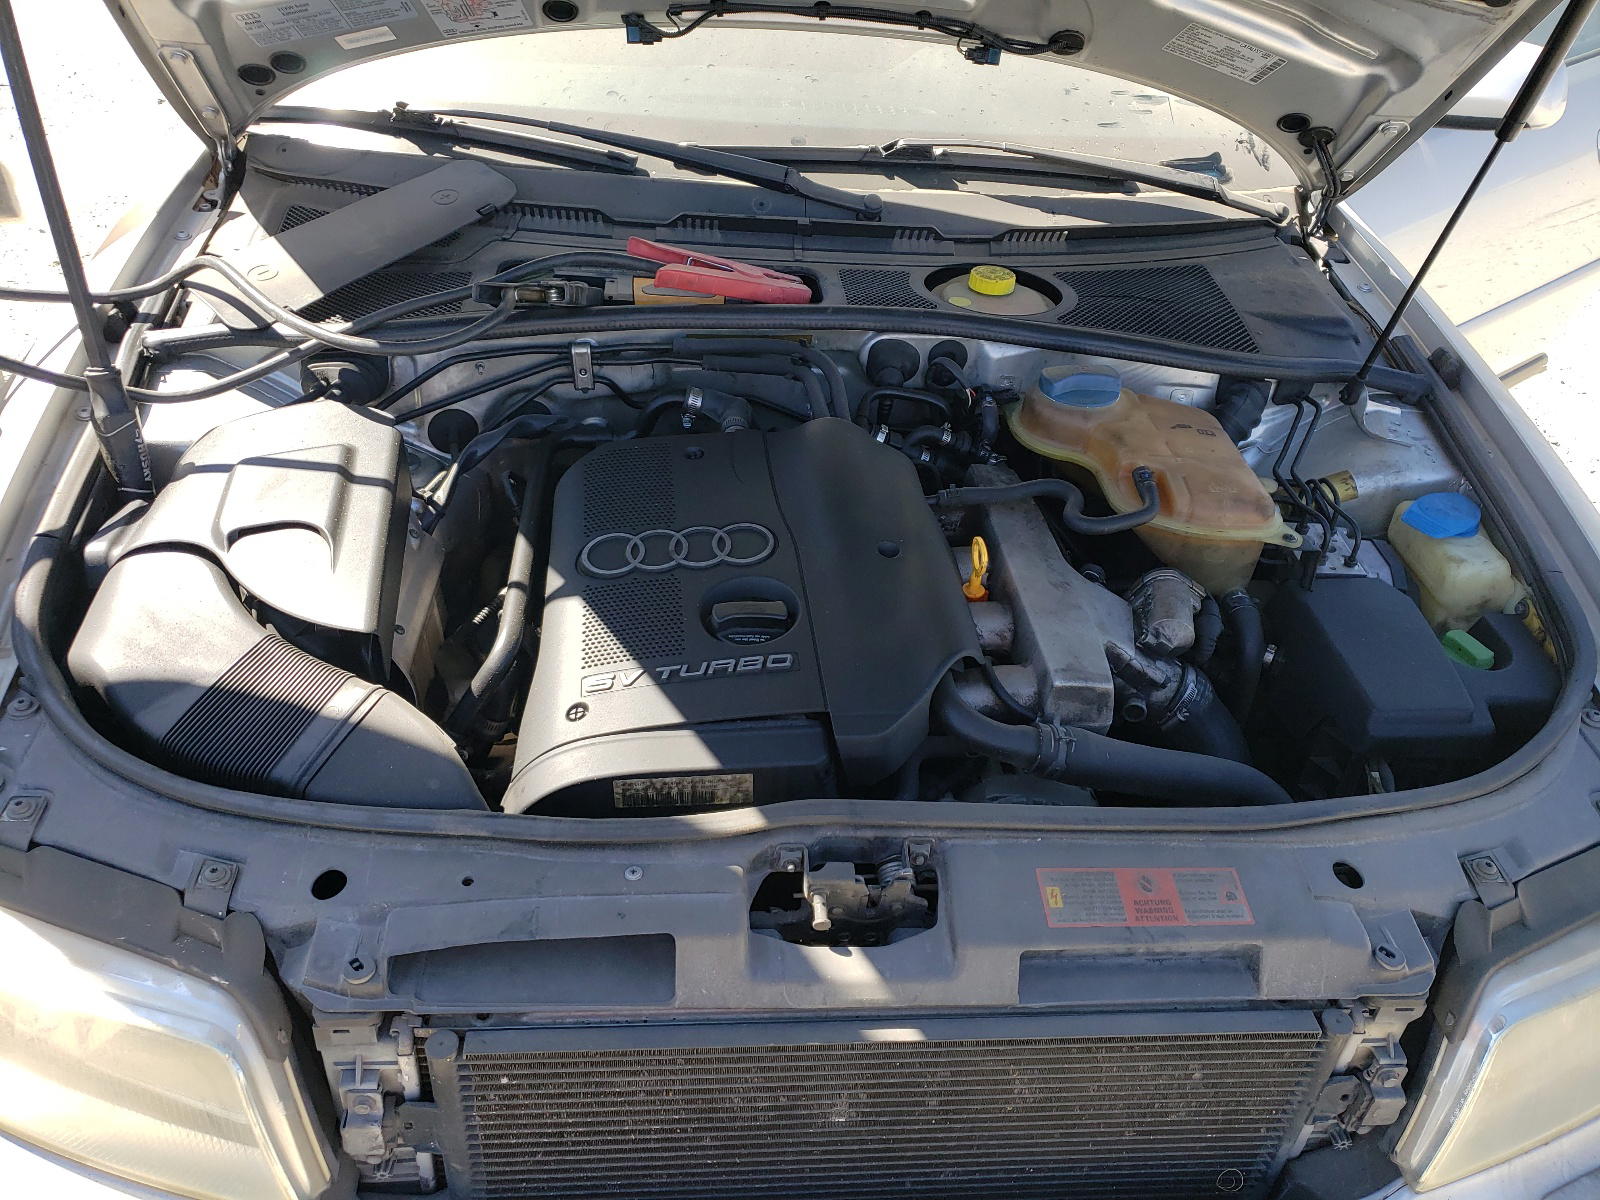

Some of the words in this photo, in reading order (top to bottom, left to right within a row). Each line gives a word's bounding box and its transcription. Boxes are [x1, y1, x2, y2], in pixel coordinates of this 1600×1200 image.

[655, 653, 794, 680] TURBO
[1133, 898, 1172, 906] ACHTUNG
[1134, 906, 1175, 914] WARNING
[1135, 914, 1179, 922] ATTENTION
